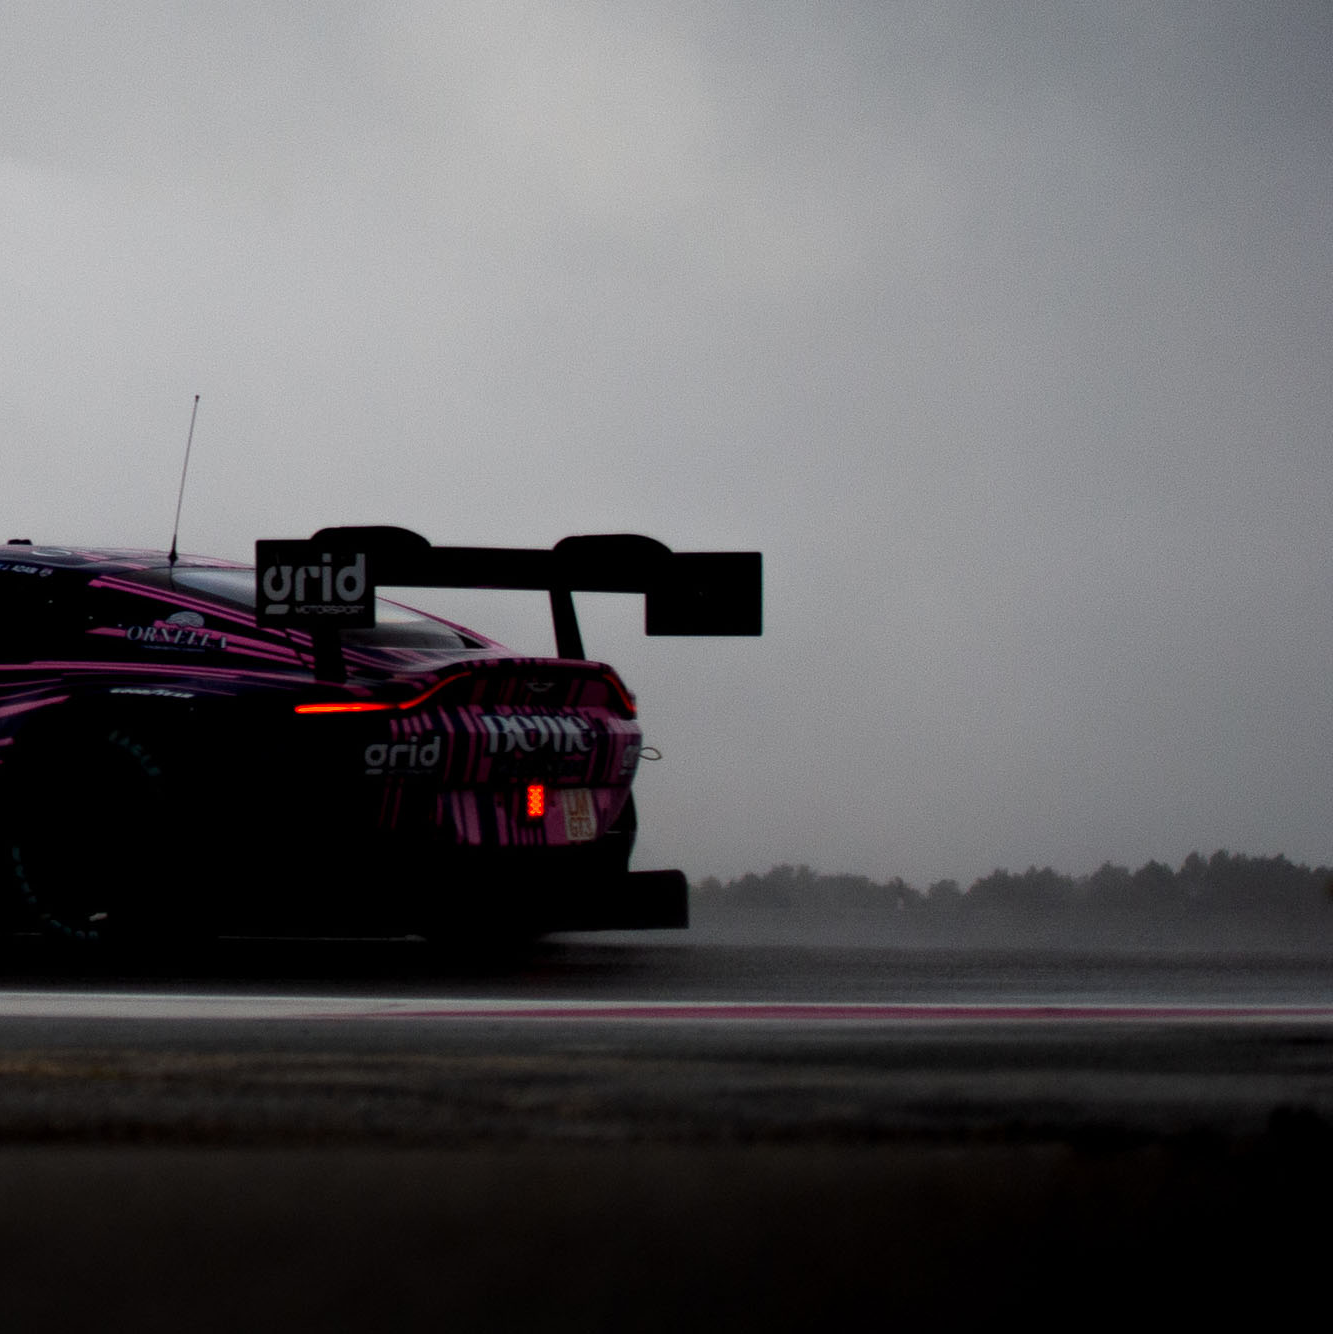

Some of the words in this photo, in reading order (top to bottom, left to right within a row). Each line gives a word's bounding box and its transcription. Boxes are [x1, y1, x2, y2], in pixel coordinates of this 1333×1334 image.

[263, 553, 366, 615] grid
[295, 605, 366, 615] MOTORSPORT
[364, 735, 441, 775] grid
